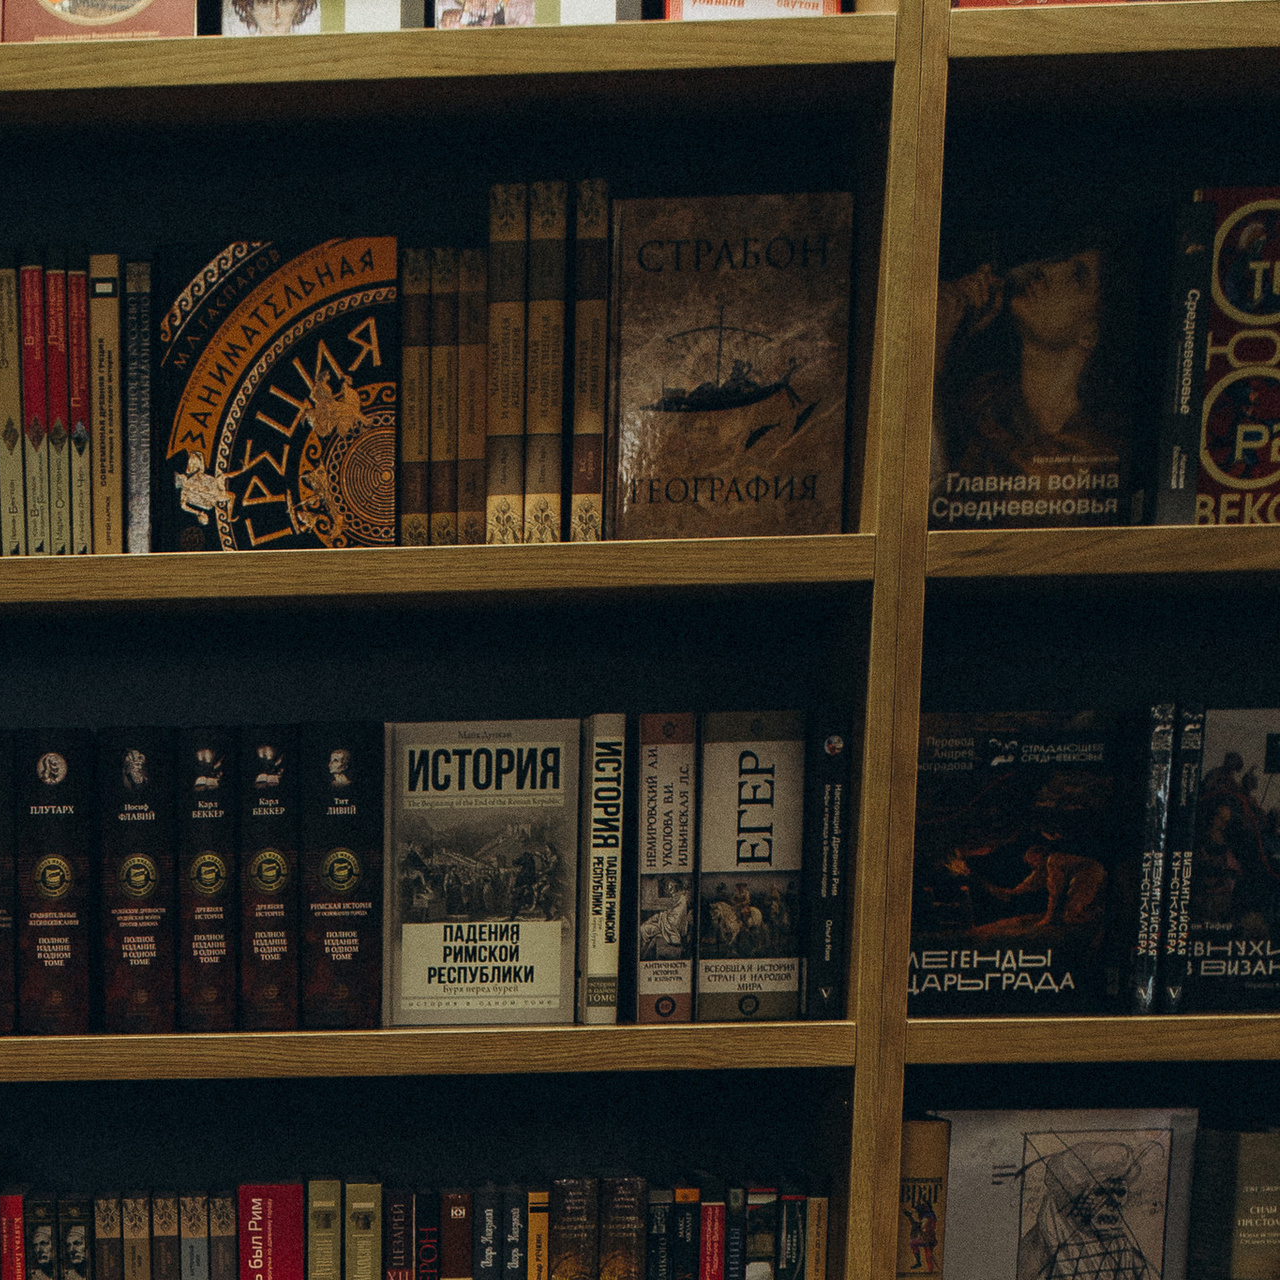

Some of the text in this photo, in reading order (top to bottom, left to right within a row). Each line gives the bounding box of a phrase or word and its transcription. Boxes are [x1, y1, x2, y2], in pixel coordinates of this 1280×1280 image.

[636, 235, 830, 274] СТРАБОН
[1178, 288, 1201, 416] Средневековье
[243, 317, 383, 547] ГРЕЦИЯ
[631, 474, 818, 505] ГЕОГРАФИЯ
[946, 469, 1120, 493] Главная война
[931, 494, 1119, 520] Средневековья
[407, 746, 561, 792] ИСТОРИЯ
[30, 804, 76, 816] ПЛУТАРХ
[591, 740, 624, 850] ИСТОРИЯ
[646, 744, 659, 868] НЕМИРОВСКИЙ А.И.
[736, 750, 776, 867] ЕГЕР
[442, 923, 520, 942] ПАДЕНИЯ
[442, 942, 520, 963] РИМСКОЙ
[704, 963, 795, 973] ВСЕОБЩАЯ ИСТОРИЯ
[908, 949, 1052, 971] ЛЕГЕНДЫ
[427, 965, 535, 984] РЕСПУБЛИКИ
[248, 1197, 263, 1232] Рим
[248, 1235, 264, 1270] был
[390, 1203, 406, 1267] ЦЕЗАРЕЙ
